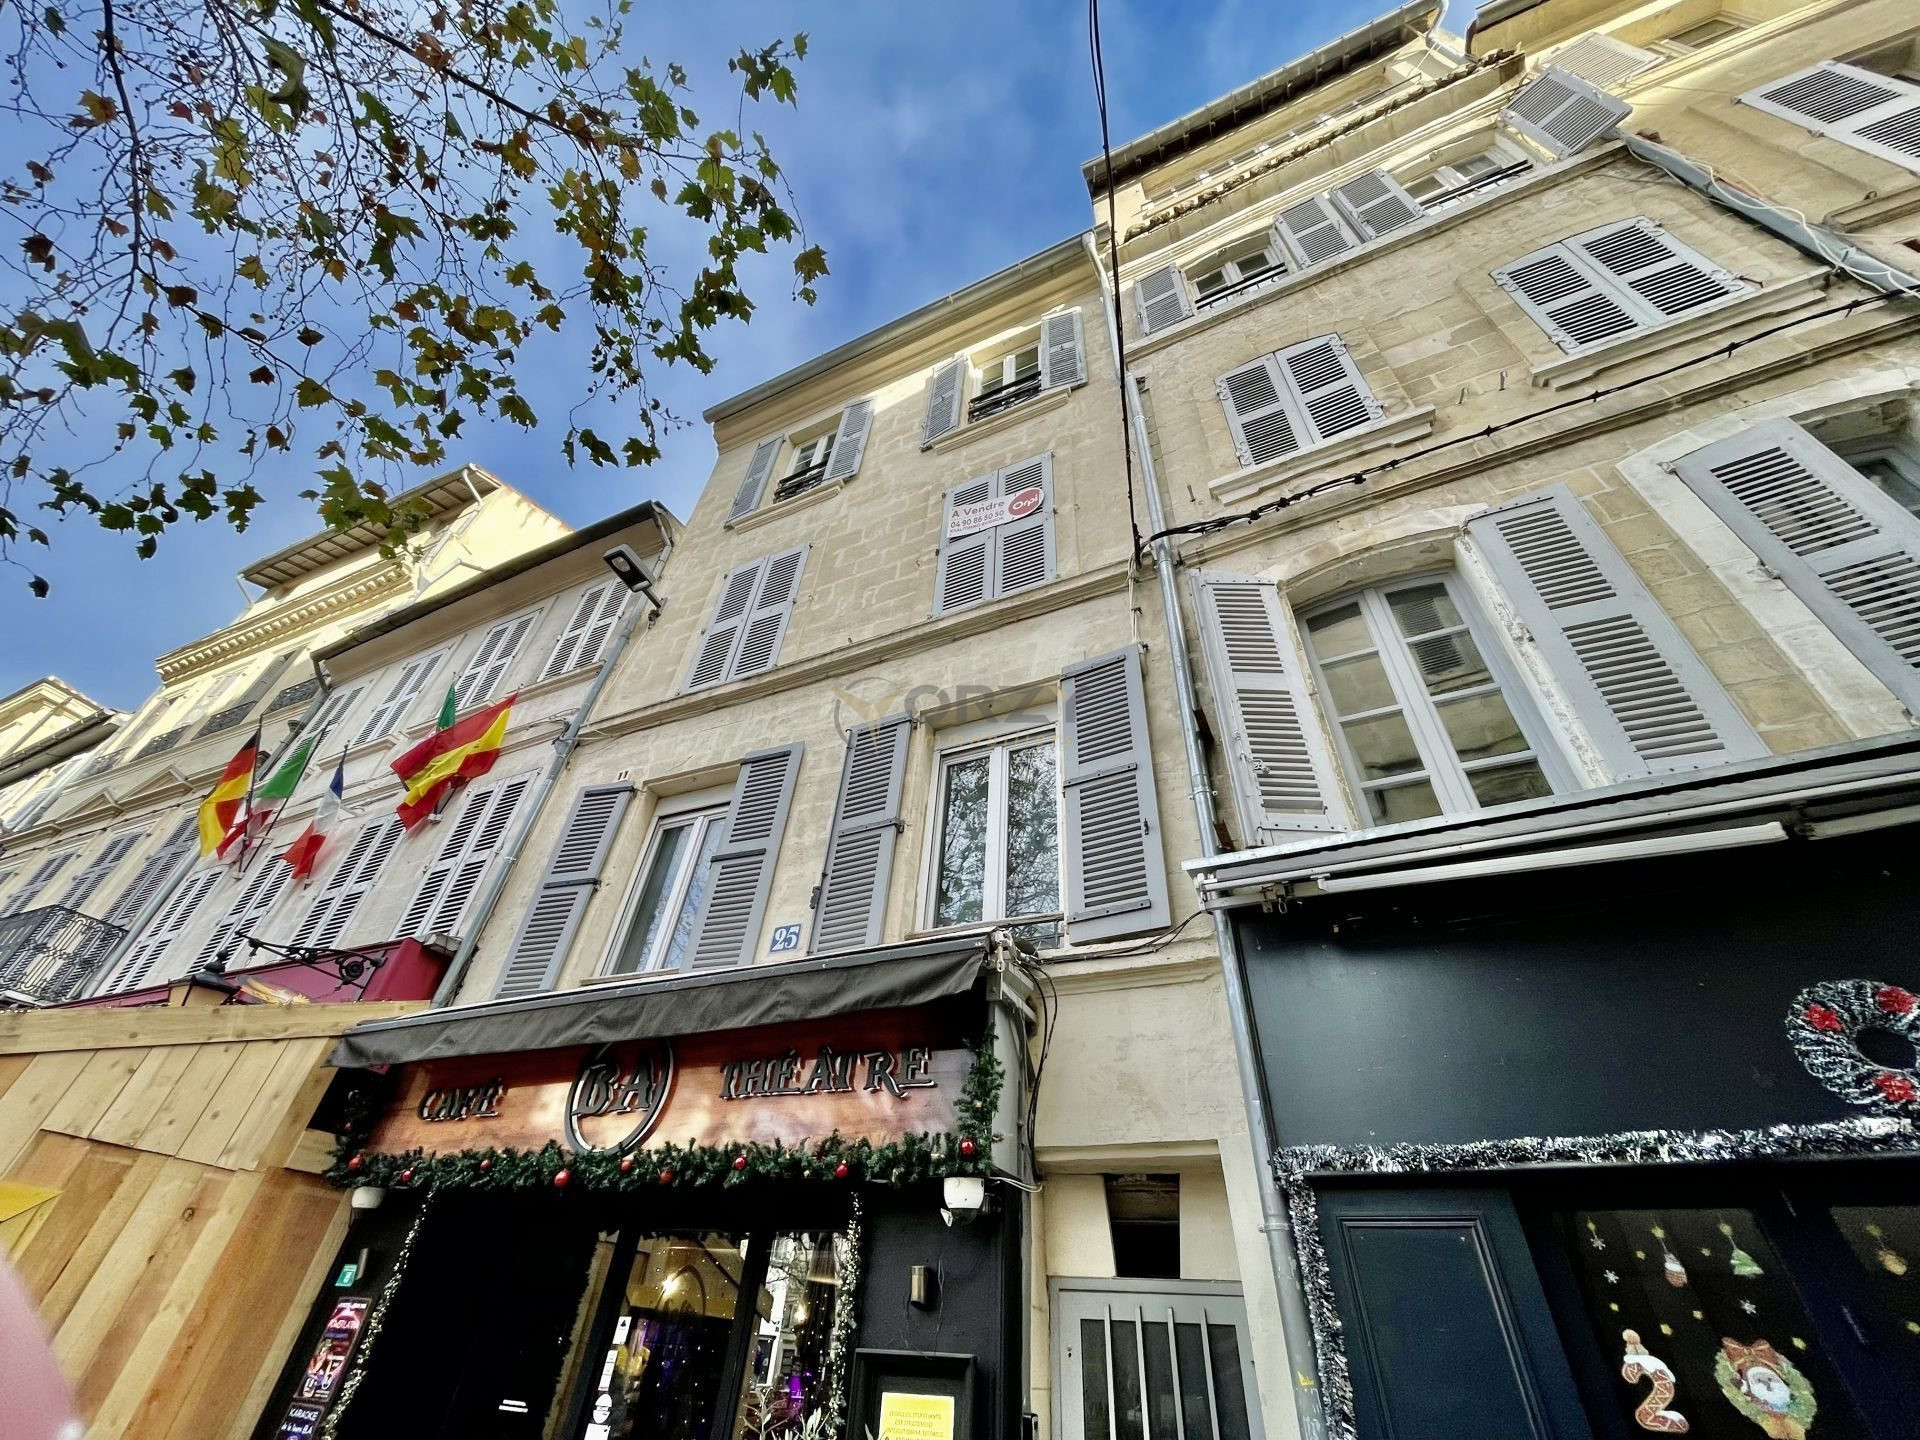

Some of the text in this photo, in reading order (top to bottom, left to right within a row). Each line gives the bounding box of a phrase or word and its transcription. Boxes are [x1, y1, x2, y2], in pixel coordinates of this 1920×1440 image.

[963, 501, 1004, 516] Vendre
[1013, 495, 1038, 509] Orpi
[950, 509, 1004, 528] 04 90 86 50 50
[772, 926, 799, 951] 25
[417, 1046, 937, 1121] CAFÉ BA THÉÂTRE
